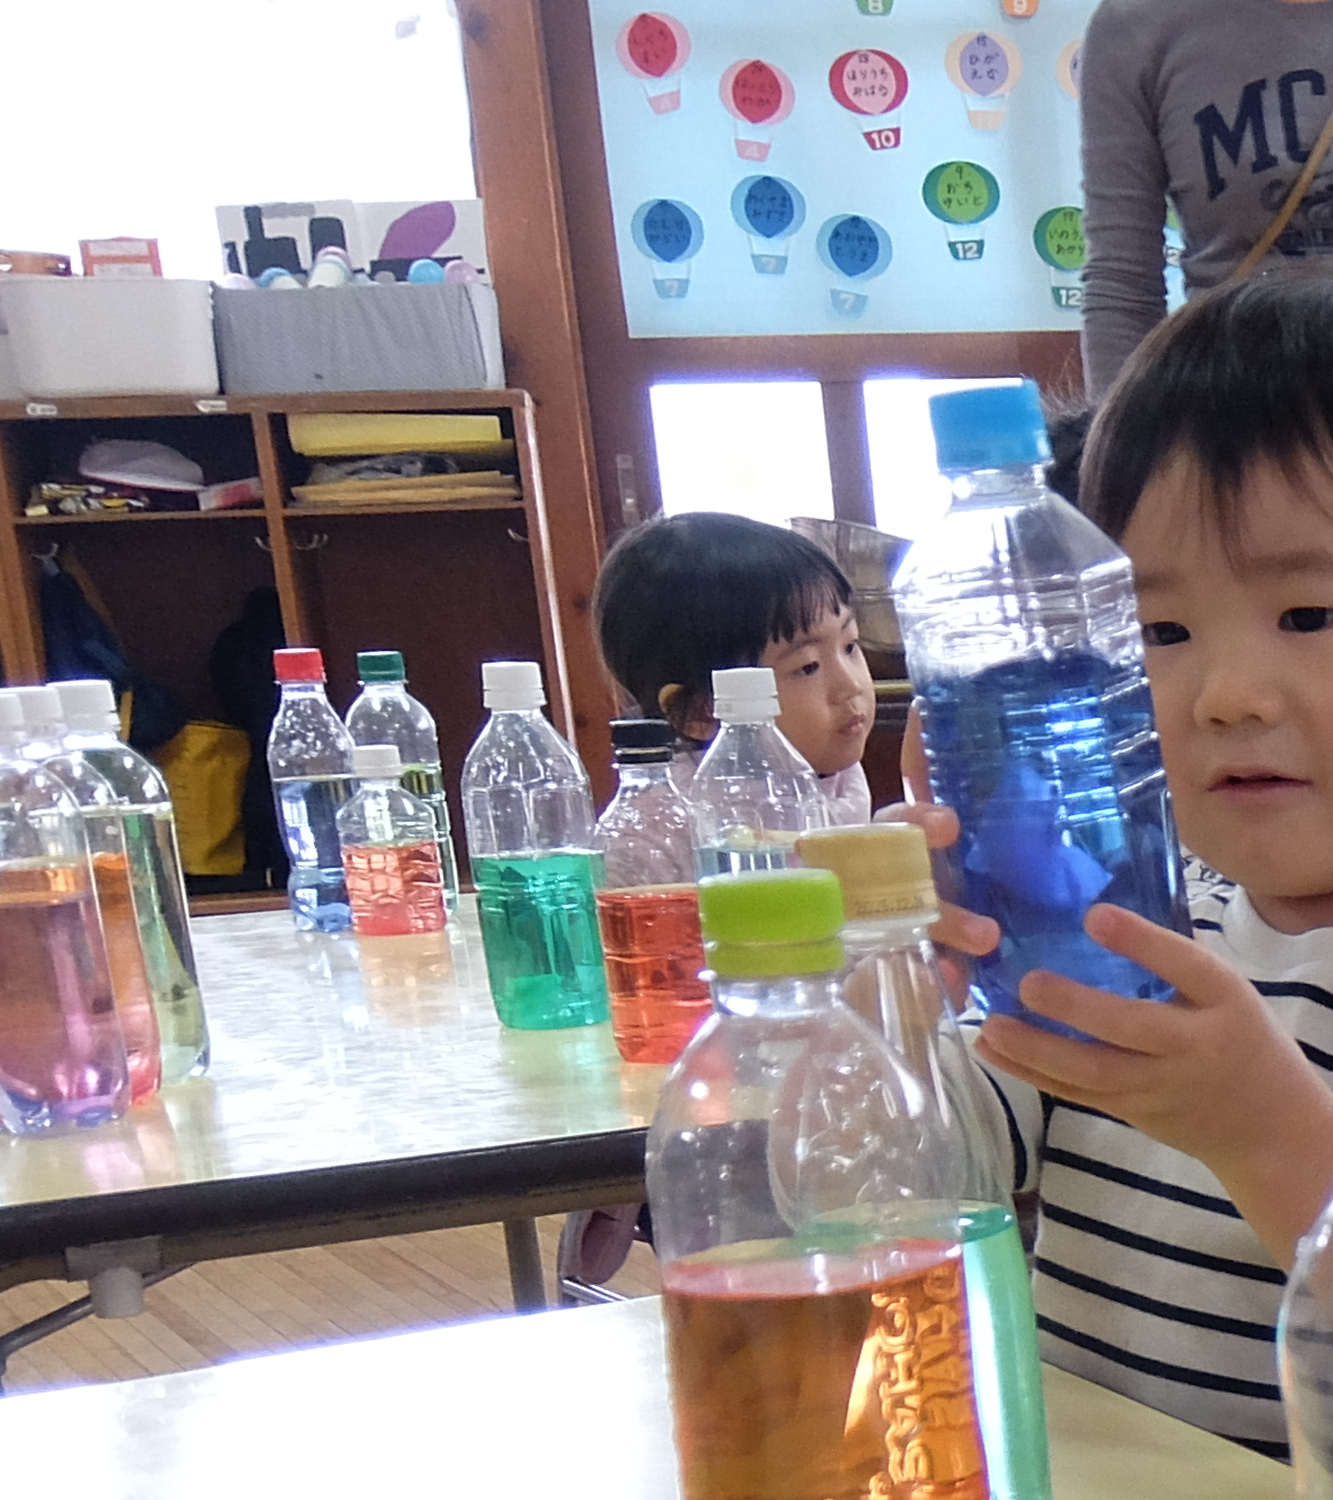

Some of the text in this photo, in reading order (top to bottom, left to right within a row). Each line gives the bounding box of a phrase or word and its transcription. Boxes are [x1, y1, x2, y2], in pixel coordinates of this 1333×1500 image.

[870, 130, 896, 149] 10
[955, 242, 979, 259] 12
[840, 293, 856, 310] 7
[1060, 288, 1082, 306] 12
